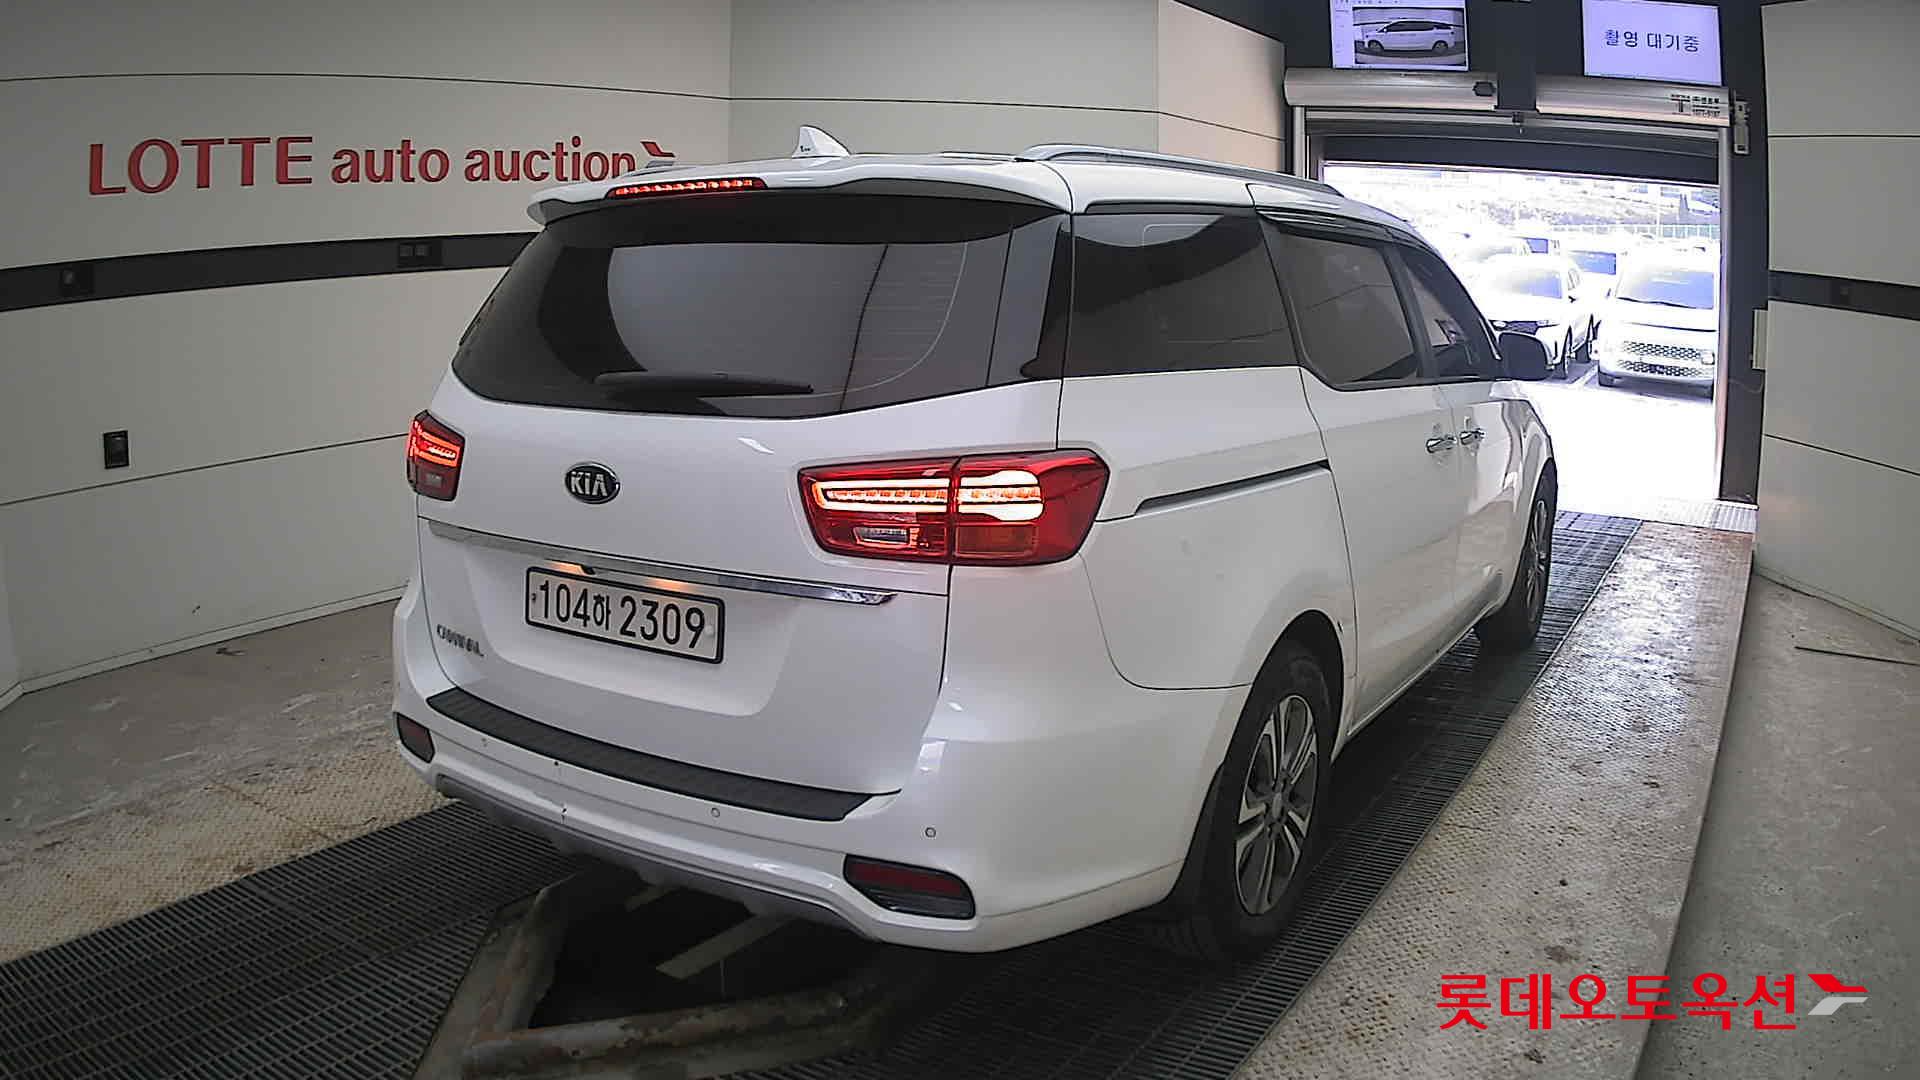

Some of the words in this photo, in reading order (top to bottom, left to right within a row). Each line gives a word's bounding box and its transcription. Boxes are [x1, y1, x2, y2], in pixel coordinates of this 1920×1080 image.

[1604, 29, 1638, 48] 촬영
[1647, 32, 1700, 52] 대기중
[89, 136, 313, 195] LOTTE
[331, 139, 450, 184] auto
[464, 136, 636, 182] auction
[571, 471, 608, 497] KIA
[620, 595, 706, 649] 2309
